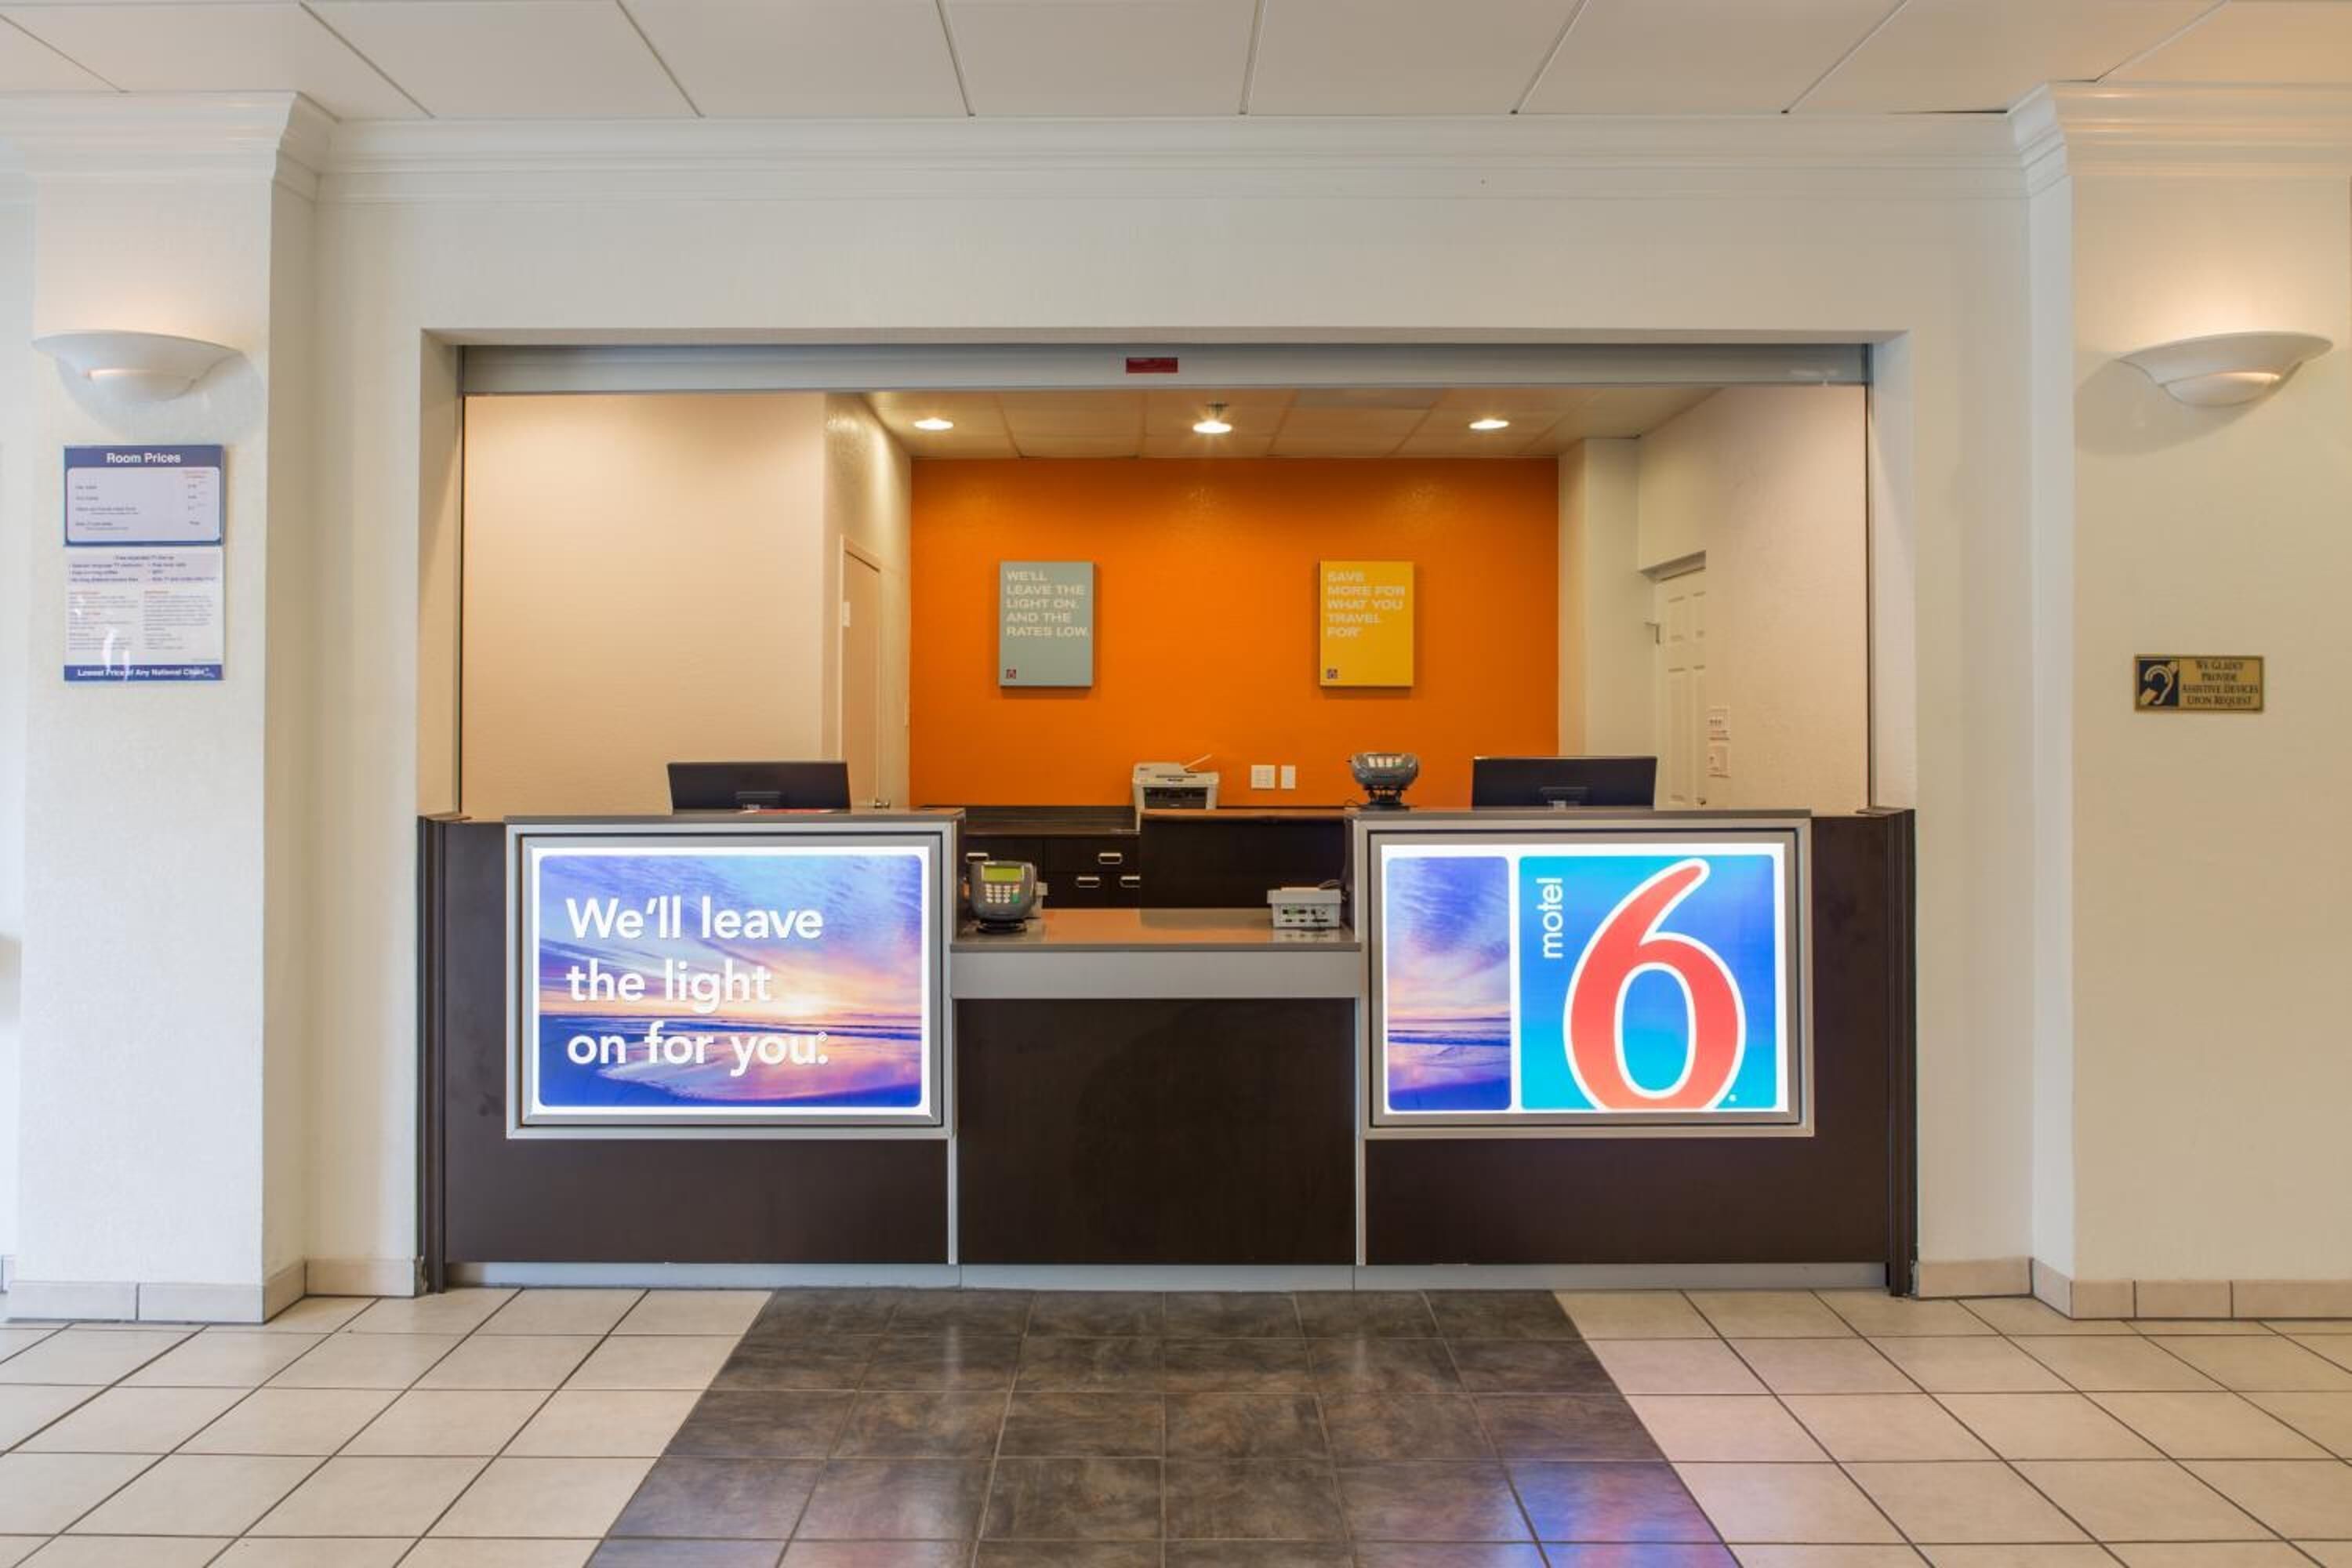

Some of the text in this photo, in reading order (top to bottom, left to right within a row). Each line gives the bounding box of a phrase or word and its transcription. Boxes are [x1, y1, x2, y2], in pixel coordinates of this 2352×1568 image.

[106, 452, 181, 463] Room Prices
[1005, 570, 1047, 582] WE'LL
[1328, 571, 1364, 582] SAVE
[1006, 585, 1086, 595] LEAVE THE
[1328, 586, 1406, 597] MORE FOR
[1006, 598, 1051, 609] LIGHT
[1328, 600, 1403, 610] WHAT YOU
[1006, 612, 1073, 623] AND THE
[1328, 613, 1380, 624] TRAVEL
[1006, 626, 1053, 637] RATES
[136, 668, 150, 678] Any
[151, 667, 182, 676] National
[566, 896, 824, 939] We'll leave
[566, 959, 772, 1014] the light
[1536, 857, 1747, 1111] motel 6
[567, 1032, 626, 1065] on
[643, 1021, 715, 1065] for
